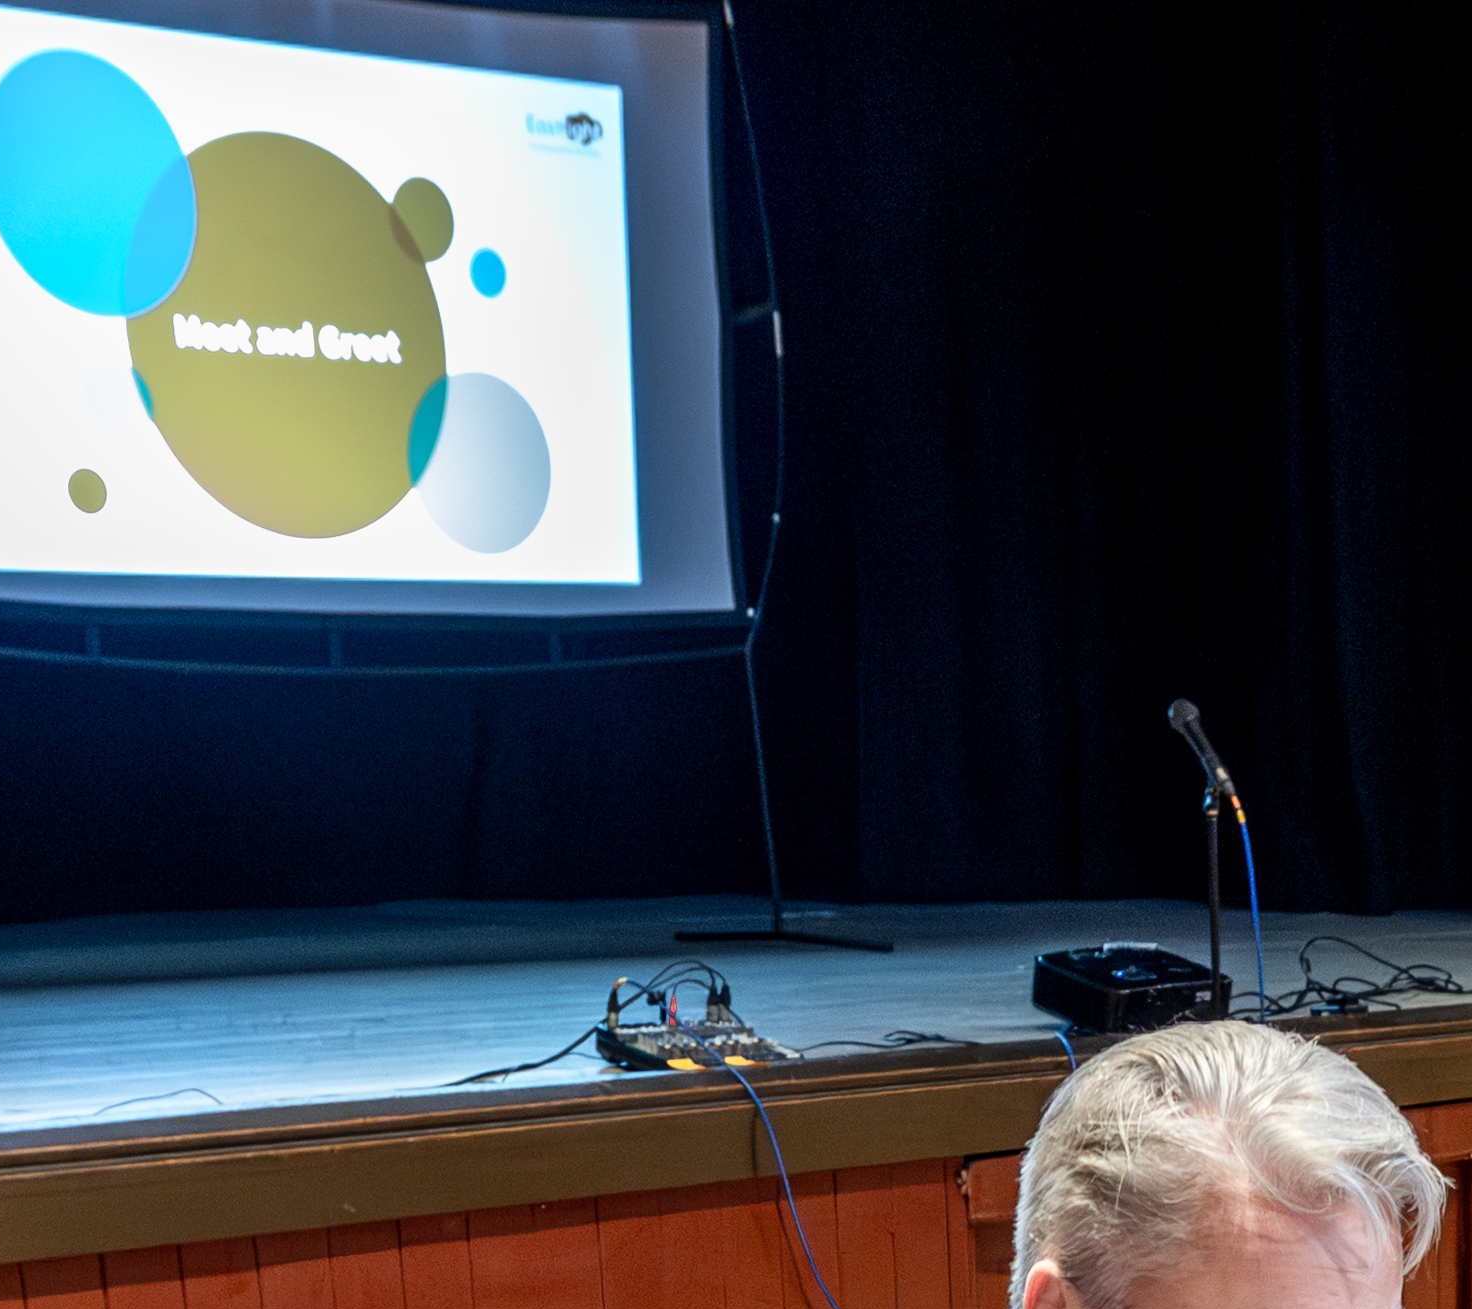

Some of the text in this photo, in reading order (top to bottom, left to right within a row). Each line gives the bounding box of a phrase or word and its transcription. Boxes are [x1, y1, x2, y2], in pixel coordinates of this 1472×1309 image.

[172, 312, 403, 364] Meet and Greet
